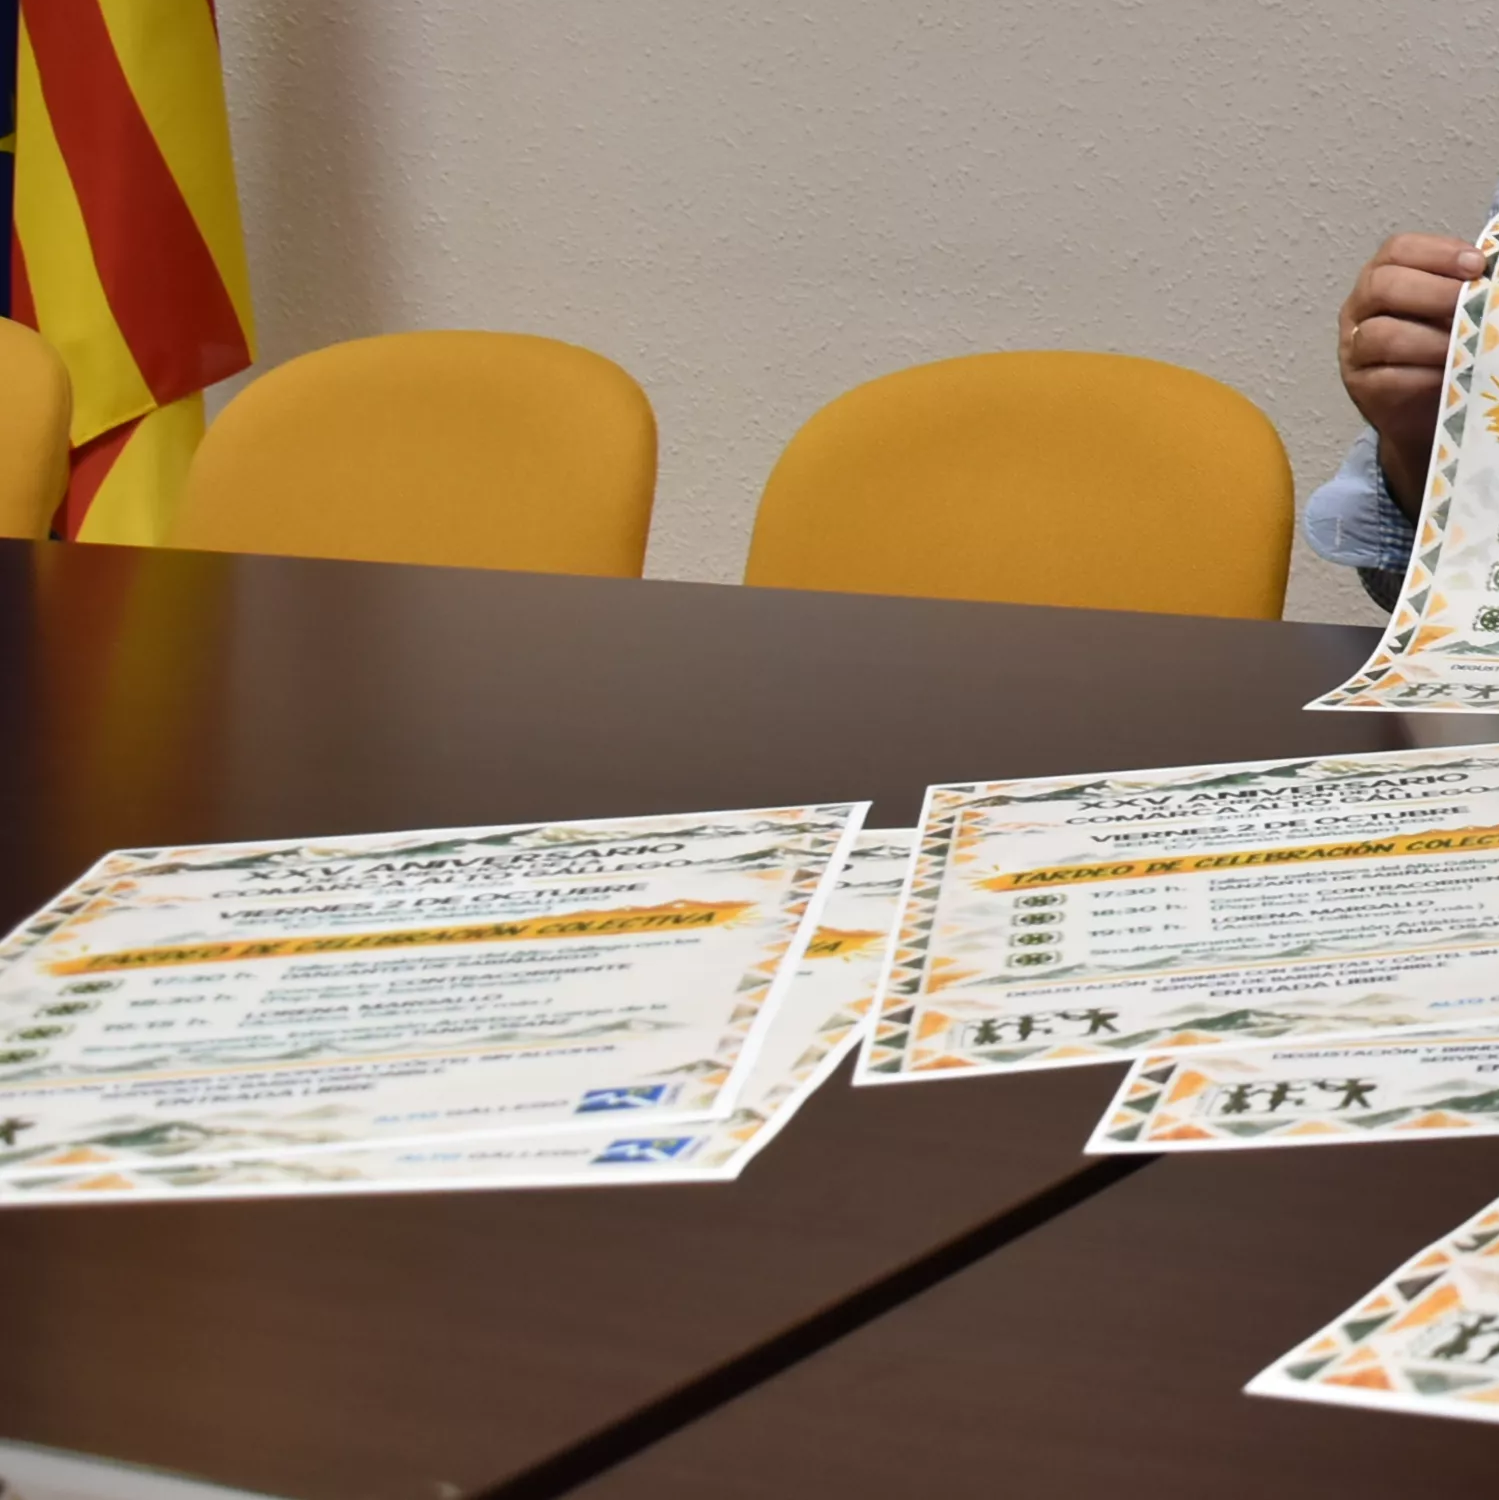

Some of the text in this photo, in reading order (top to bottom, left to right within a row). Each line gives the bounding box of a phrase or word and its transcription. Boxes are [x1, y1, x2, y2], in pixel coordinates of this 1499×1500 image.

[1009, 865, 1135, 886] TARDEO
[1146, 860, 1182, 873] DE
[1194, 842, 1395, 870] CELEBRACIÓN
[536, 911, 716, 934] COLECTIVA
